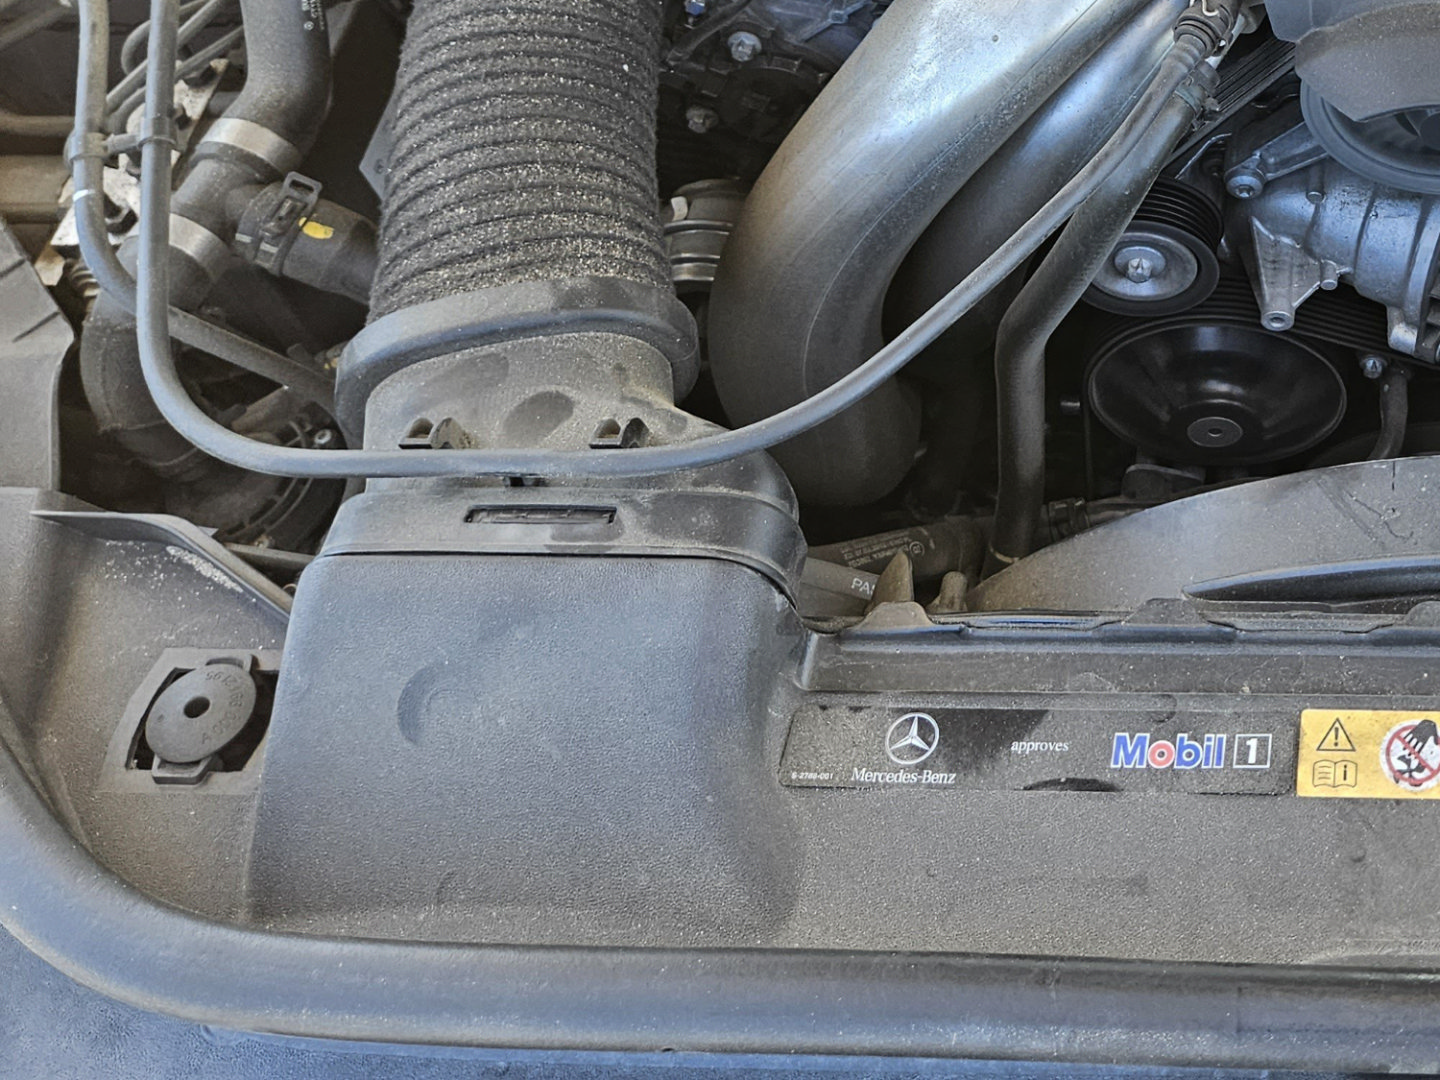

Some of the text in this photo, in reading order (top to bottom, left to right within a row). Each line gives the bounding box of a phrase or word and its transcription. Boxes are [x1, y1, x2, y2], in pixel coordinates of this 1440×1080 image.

[1010, 740, 1070, 754] approves
[1110, 732, 1227, 769] Mobil
[850, 767, 957, 785] Mercedes-Benz
